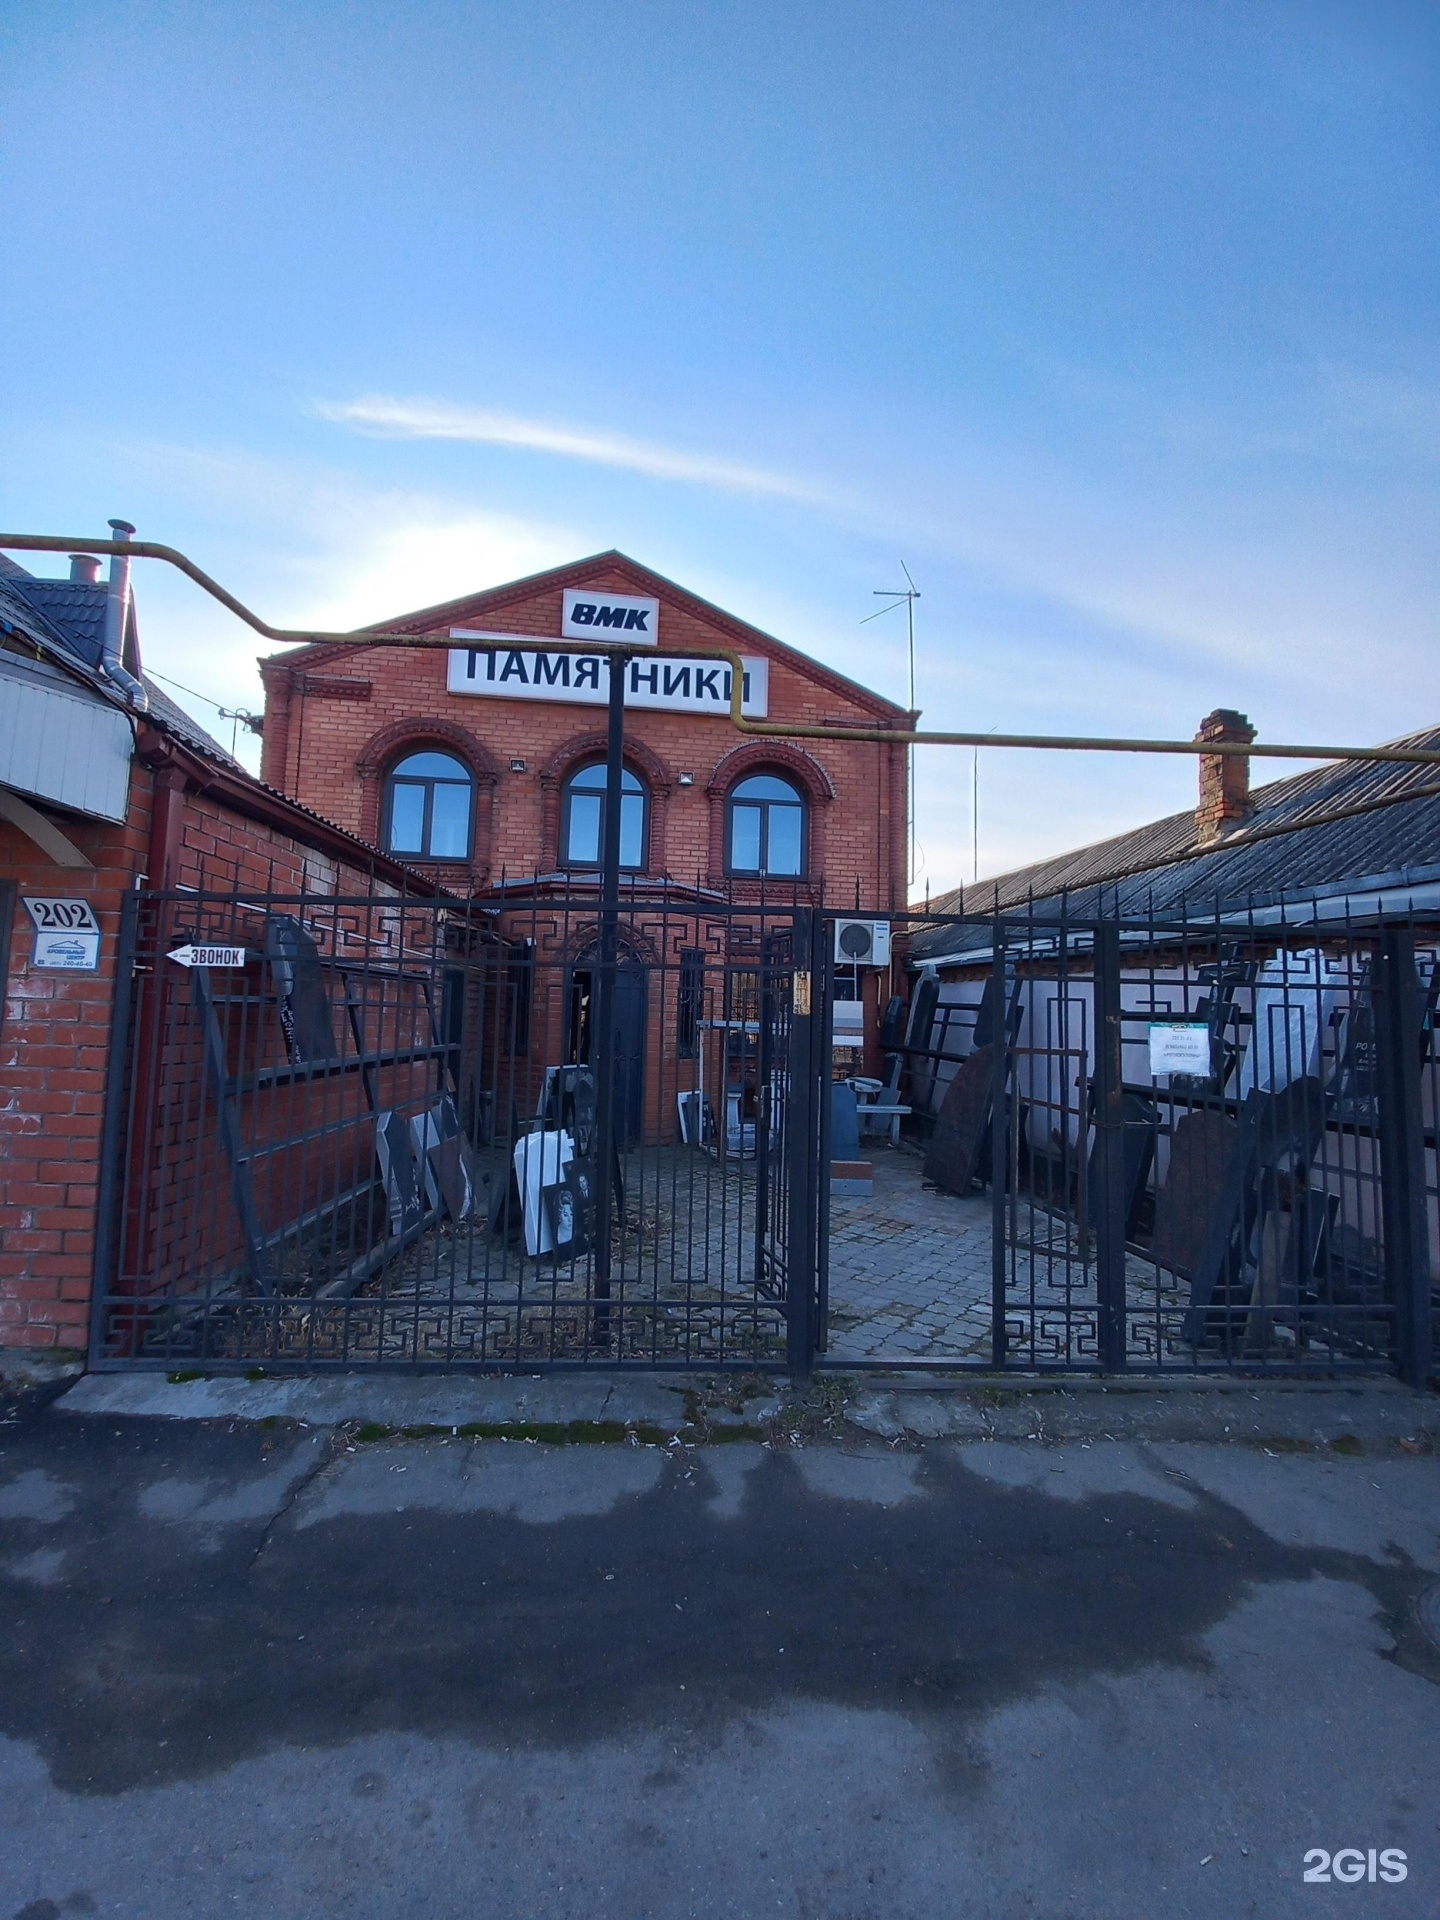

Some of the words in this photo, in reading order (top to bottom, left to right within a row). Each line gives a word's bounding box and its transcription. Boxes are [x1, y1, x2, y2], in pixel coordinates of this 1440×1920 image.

[571, 603, 651, 631] ВМК
[466, 649, 751, 703] ПАМЯНИКИ
[34, 903, 93, 928] 202
[191, 949, 240, 965] ЗВОНОК
